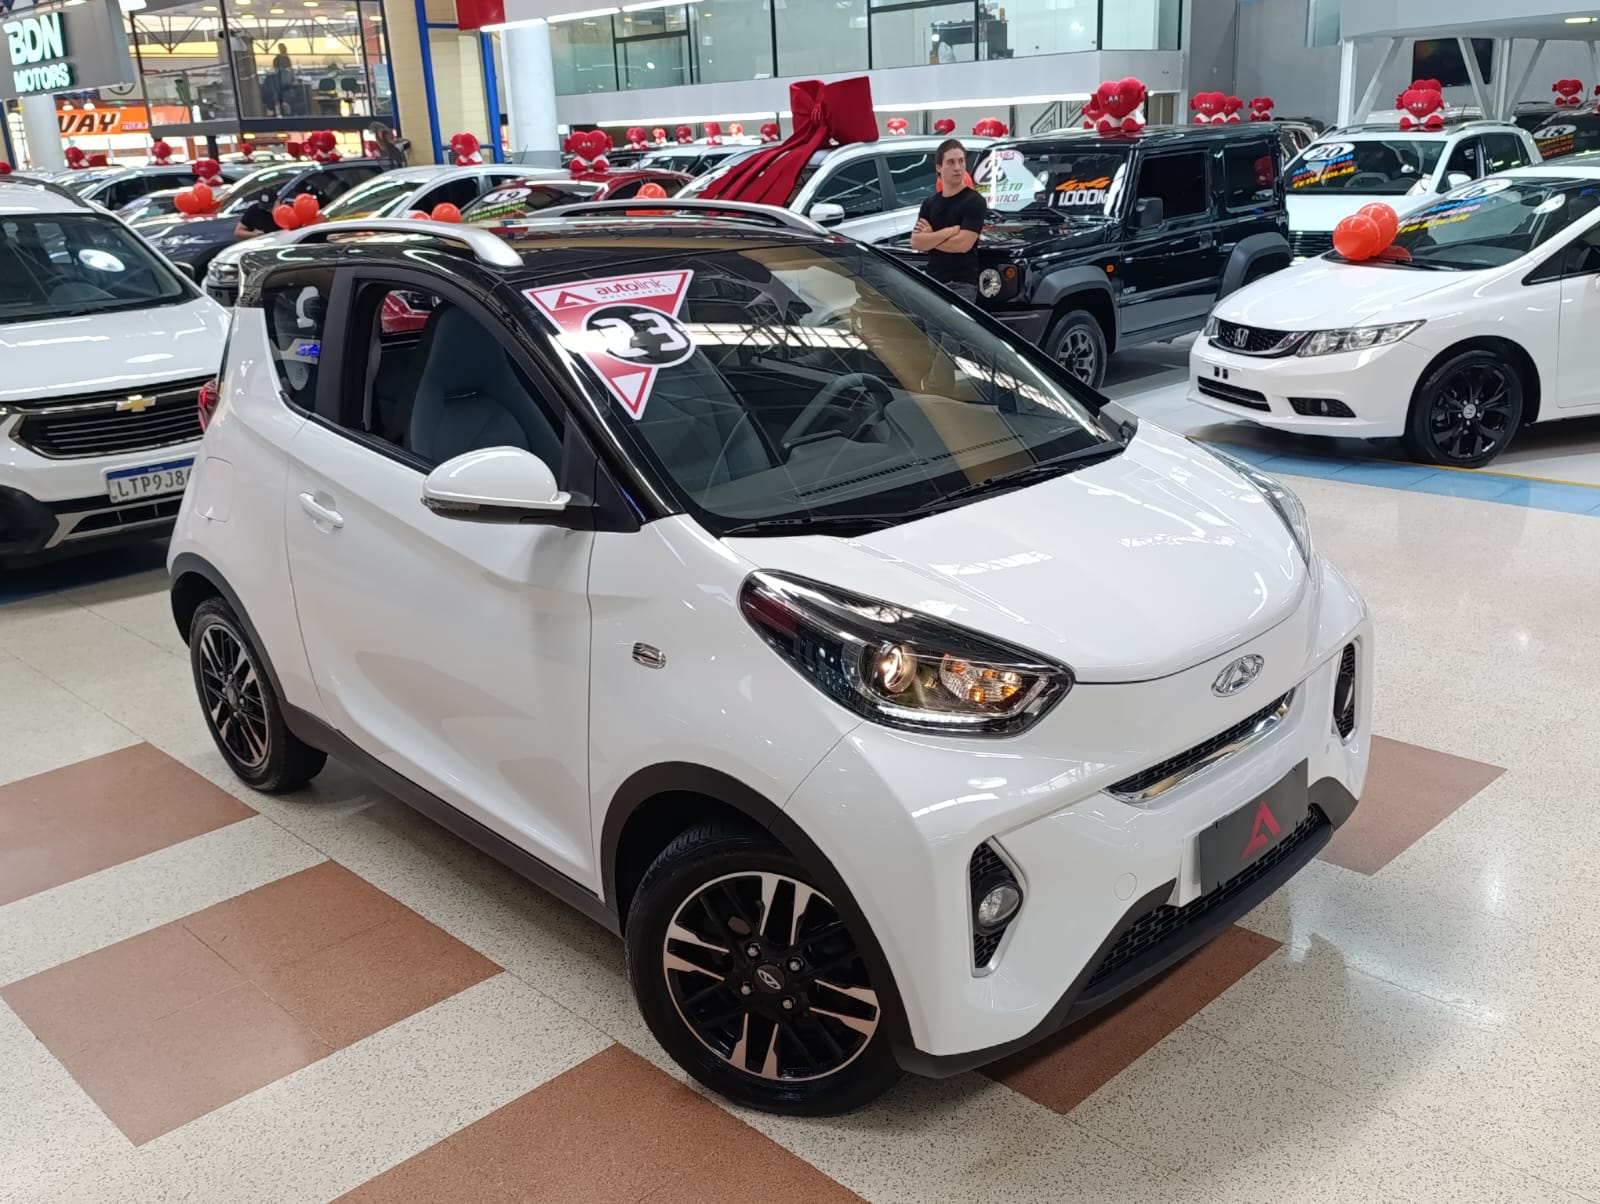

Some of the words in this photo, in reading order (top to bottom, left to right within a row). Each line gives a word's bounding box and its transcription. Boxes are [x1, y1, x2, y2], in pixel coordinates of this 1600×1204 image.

[3, 12, 64, 66] BDN
[13, 63, 71, 93] MOTORS
[1310, 146, 1344, 160] 20
[594, 278, 667, 295] autolink
[592, 312, 690, 358] 23
